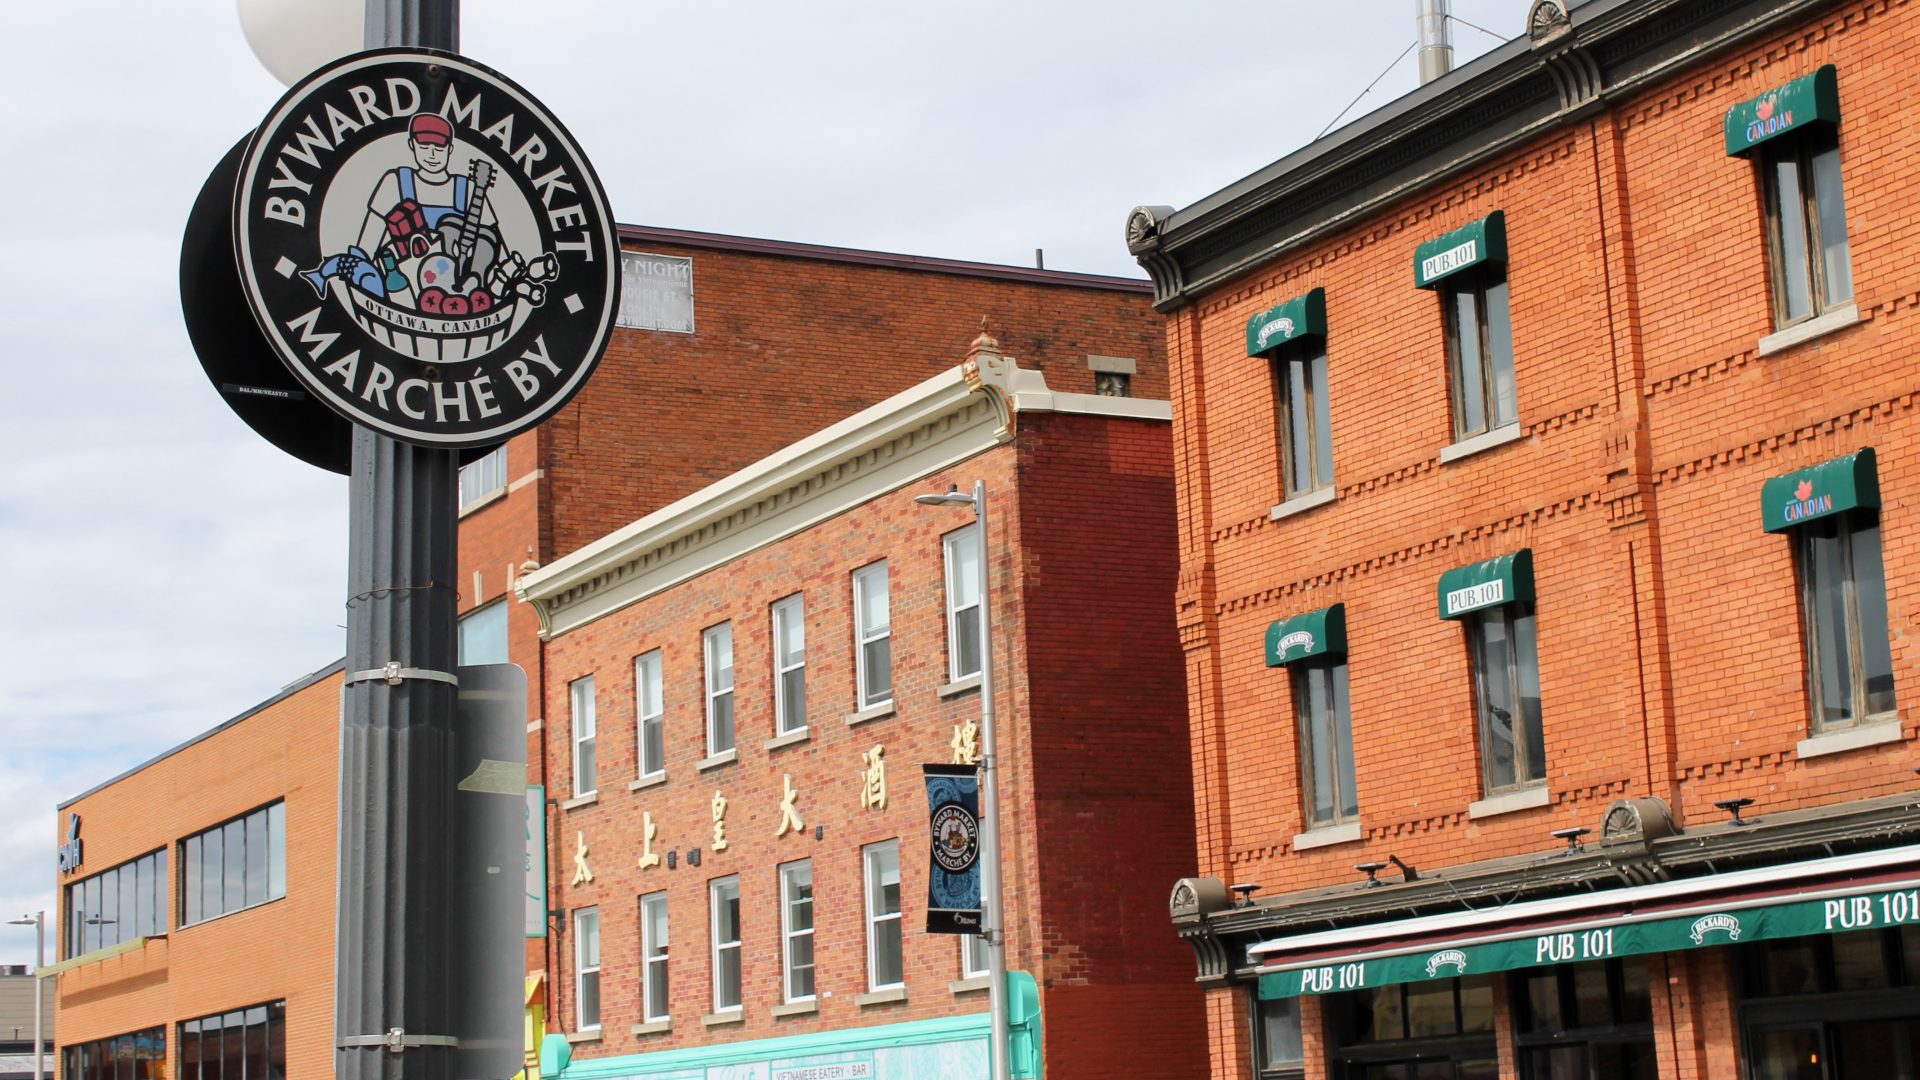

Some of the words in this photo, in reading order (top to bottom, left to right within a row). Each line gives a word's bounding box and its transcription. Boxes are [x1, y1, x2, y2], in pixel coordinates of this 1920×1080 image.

[1746, 110, 1793, 142] CANADIAN
[264, 77, 421, 228] BYWARD
[438, 82, 594, 262] MARKET
[635, 259, 689, 279] NIGHT
[365, 299, 434, 333] OTTAWA,
[441, 313, 501, 333] CANADA
[285, 306, 502, 423] MARCHÉ
[502, 333, 562, 401] BY
[1784, 494, 1832, 522] CANADIAN
[934, 809, 952, 837] BYWARD
[953, 809, 976, 838] MARKET
[963, 851, 972, 862] BY
[1694, 915, 1735, 934] RICKARD'S
[1824, 896, 1873, 929] PUB
[1879, 890, 1919, 923] 101
[1536, 933, 1575, 962] PUB
[1581, 928, 1613, 958] 101
[1300, 966, 1333, 993] PUB
[1337, 962, 1365, 989] 101
[776, 1069, 818, 1080] VIETNAMESE
[818, 1065, 845, 1079] EATERY
[852, 1064, 867, 1077] BAR
